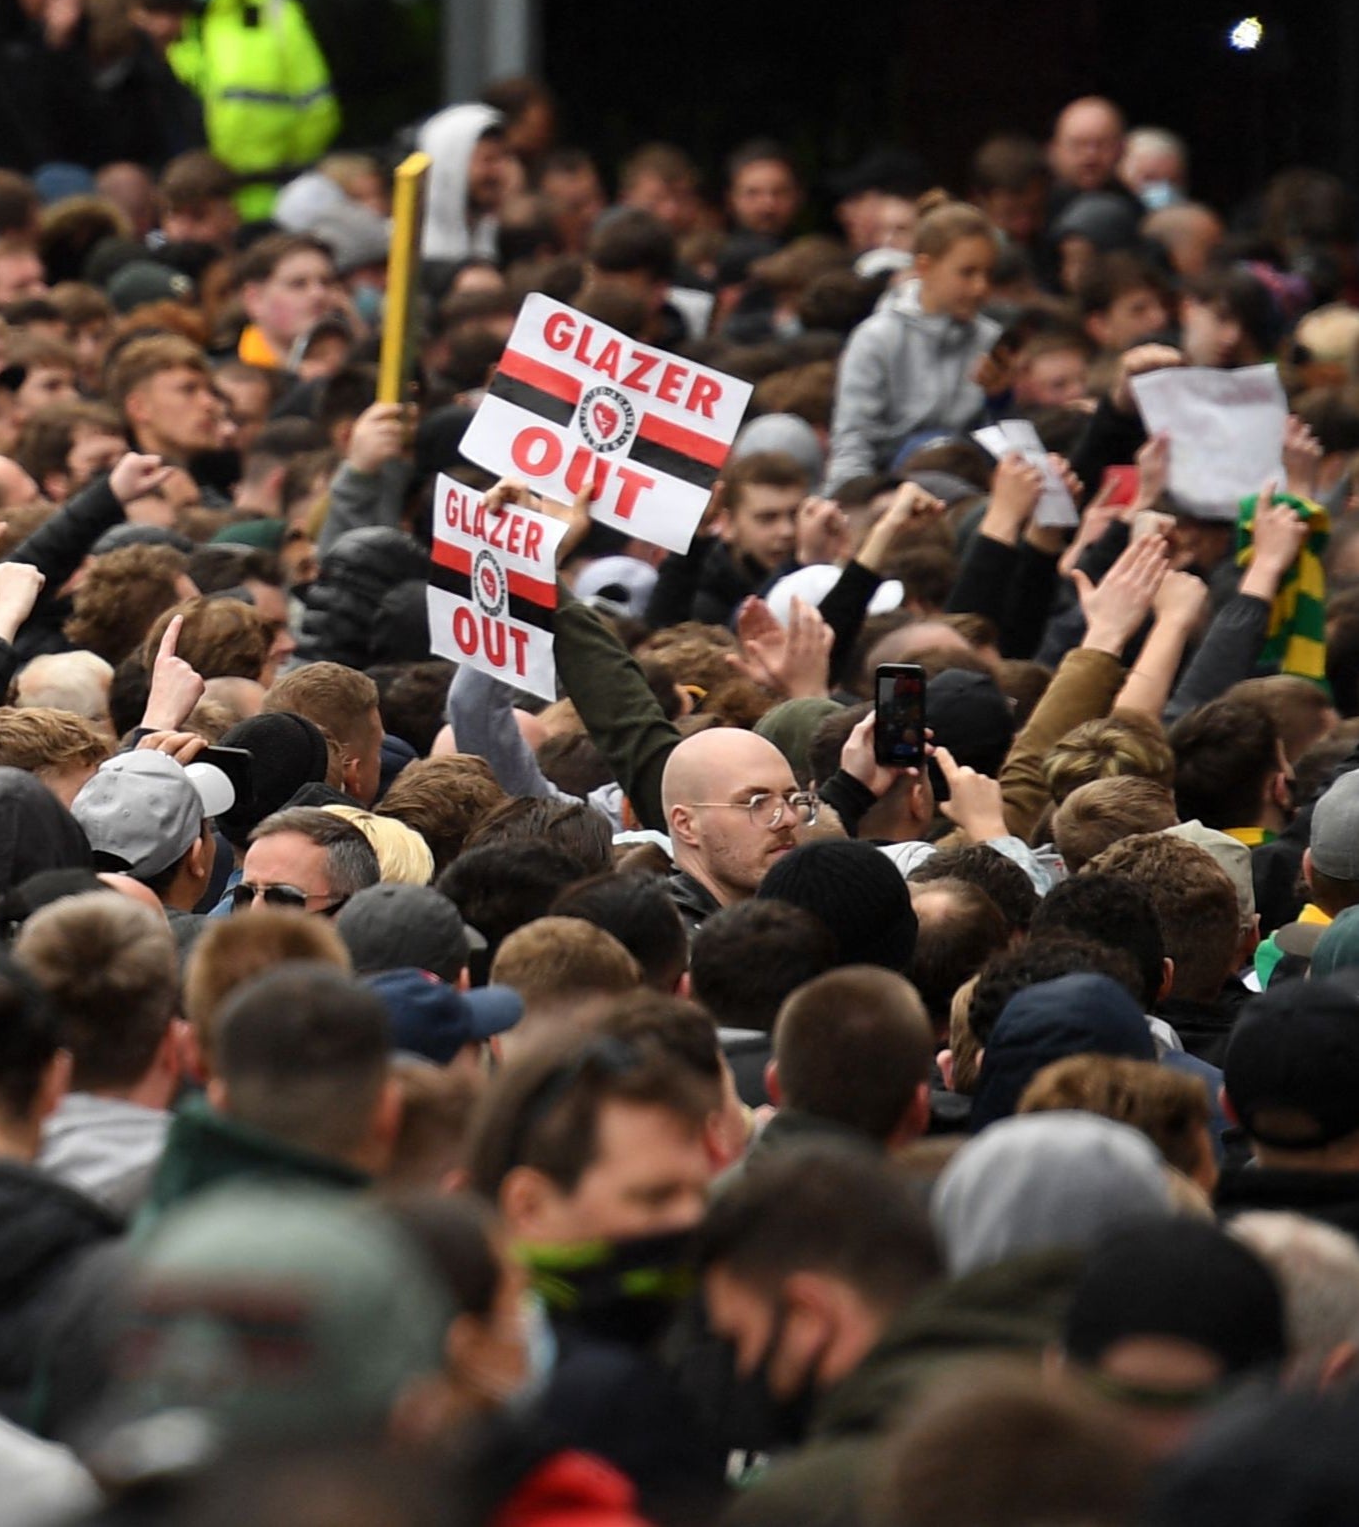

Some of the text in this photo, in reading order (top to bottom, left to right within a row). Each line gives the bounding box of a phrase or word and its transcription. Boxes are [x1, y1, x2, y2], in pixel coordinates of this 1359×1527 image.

[542, 311, 723, 420] GLAZER
[510, 426, 657, 520] OUT
[444, 487, 545, 563] GLAZER
[452, 605, 530, 677] OUT
